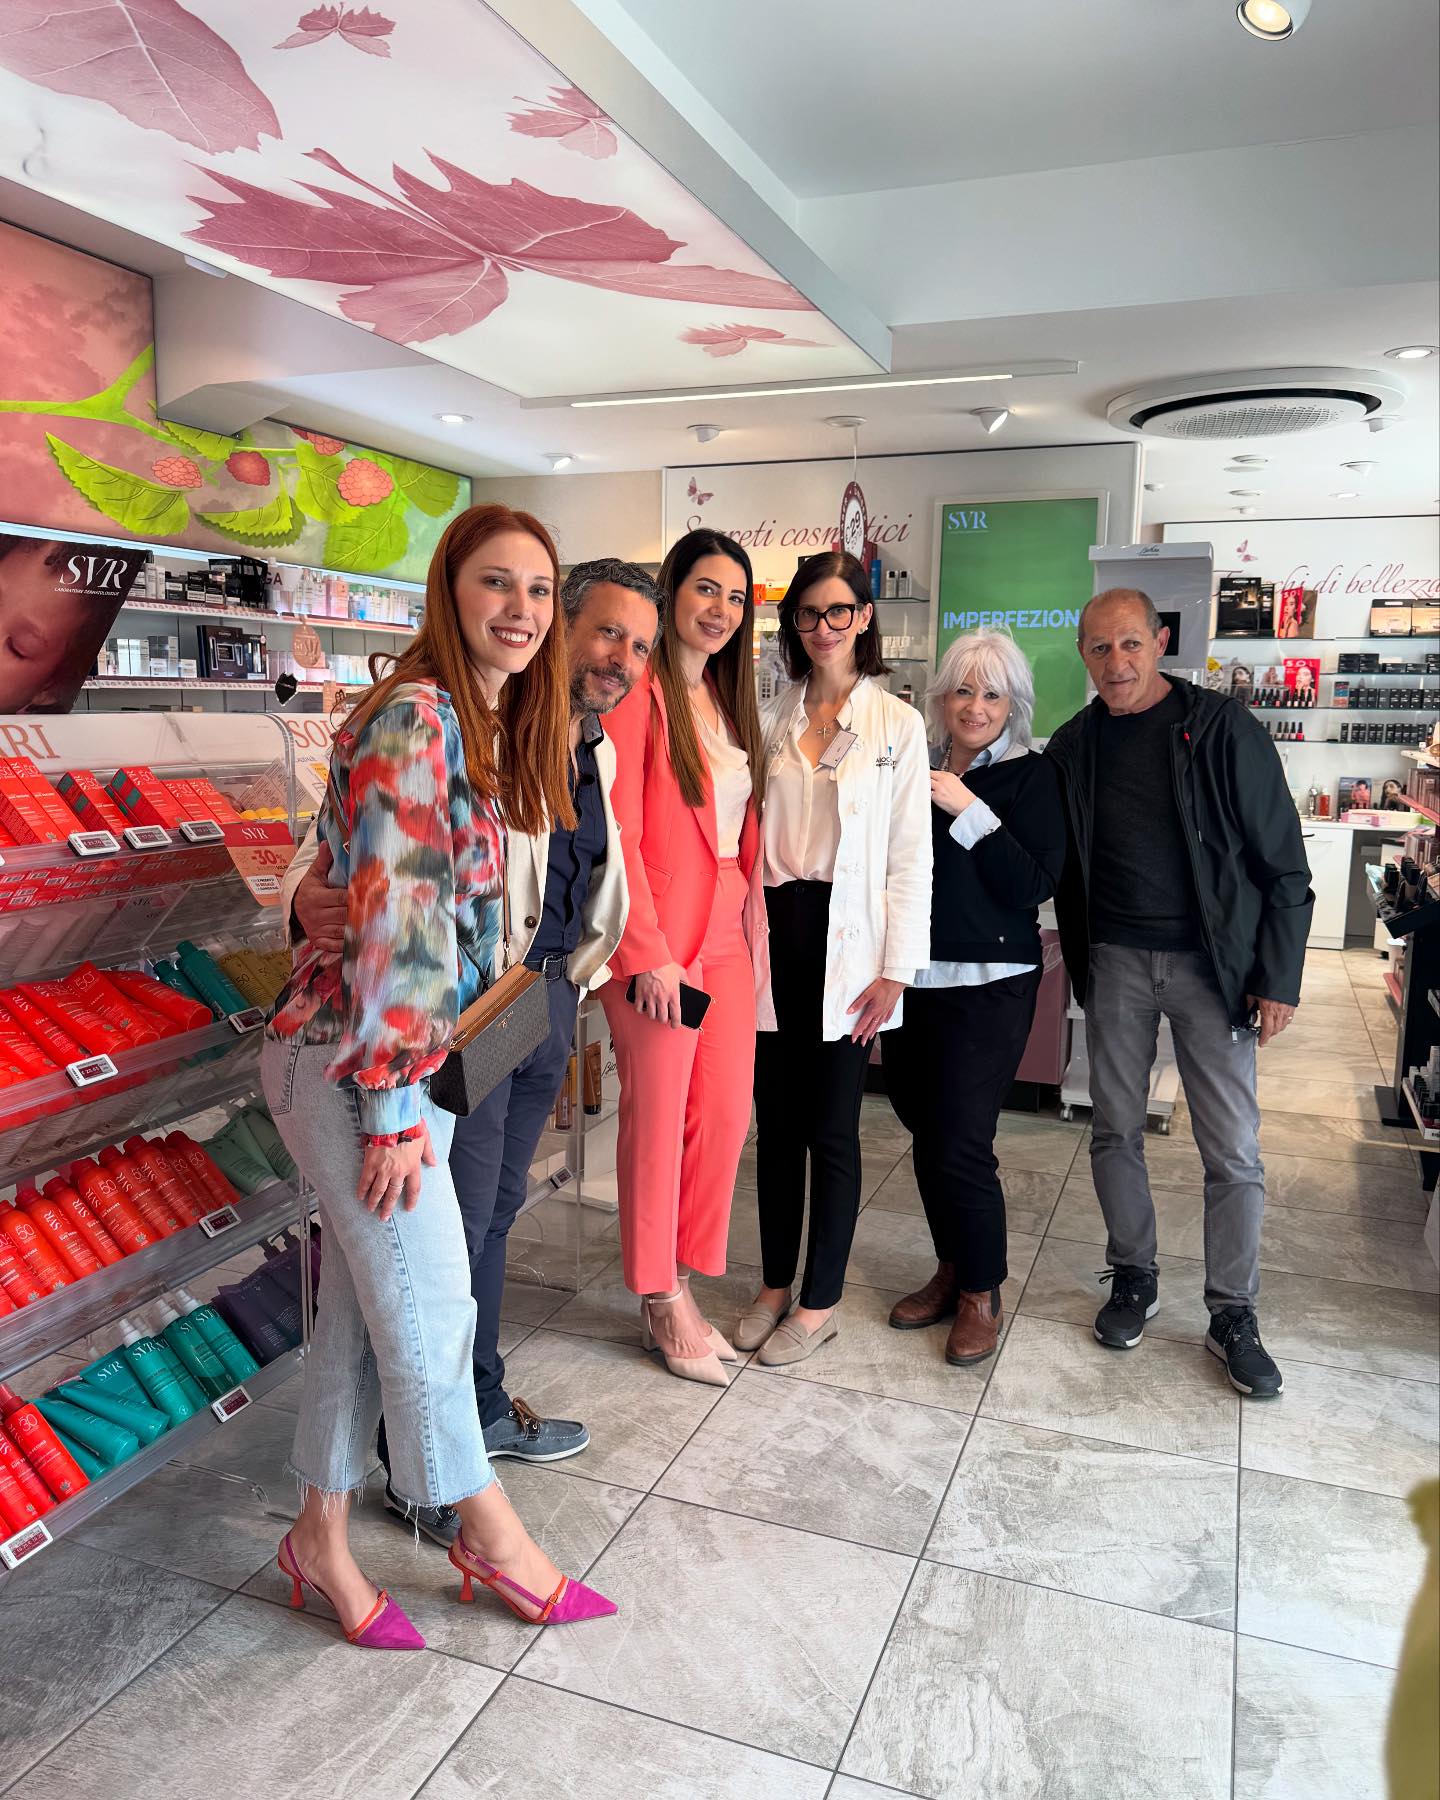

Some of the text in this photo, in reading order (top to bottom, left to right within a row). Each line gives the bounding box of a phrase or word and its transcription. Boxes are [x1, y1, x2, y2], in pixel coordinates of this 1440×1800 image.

[780, 513, 913, 547] cosmtici
[947, 510, 989, 530] SVR
[59, 554, 128, 589] SVR
[1314, 564, 1344, 594] di
[1345, 563, 1440, 599] bellezza
[241, 827, 269, 840] SVR
[12, 994, 30, 1012] SVR
[141, 1162, 158, 1182] SVR
[115, 1172, 133, 1193] SVR
[85, 1187, 101, 1208] SVR
[72, 1198, 90, 1218] SVR
[43, 1209, 62, 1231] SVR
[15, 1223, 35, 1240] 50
[132, 1341, 155, 1361] SVR
[96, 1360, 124, 1382] SVR
[18, 1413, 38, 1432] 30
